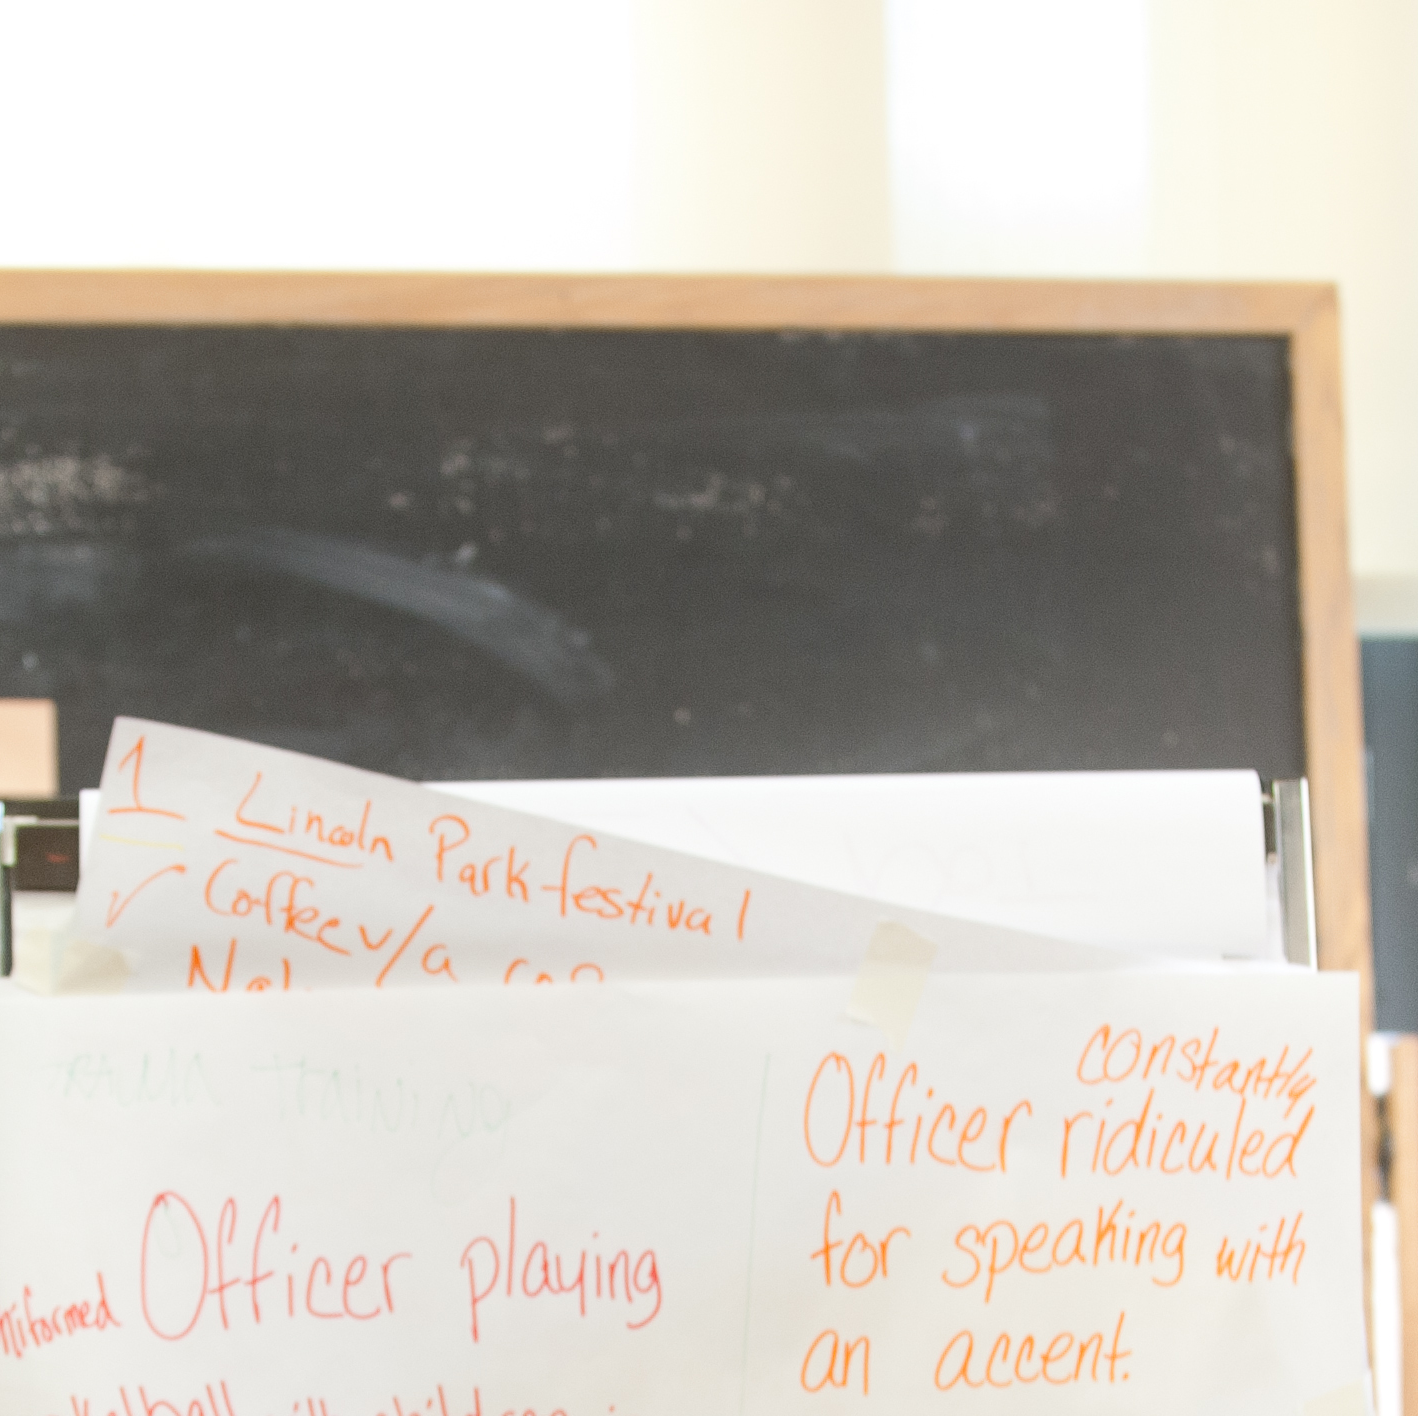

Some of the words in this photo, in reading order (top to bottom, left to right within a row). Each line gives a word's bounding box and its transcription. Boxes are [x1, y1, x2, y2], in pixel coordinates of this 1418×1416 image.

[234, 771, 395, 862] Lincoln
[428, 813, 530, 904] Park
[203, 858, 352, 957] Coffee
[803, 1051, 1033, 1175] Officer
[1060, 1086, 1316, 1181] ridiculed
[140, 1190, 412, 1341] Officer
[461, 1195, 664, 1344] playing
[809, 1189, 912, 1288] for
[941, 1198, 1188, 1304] speaking
[1213, 1211, 1307, 1286] with
[800, 1327, 871, 1397] an
[934, 1309, 1133, 1392] accent.
